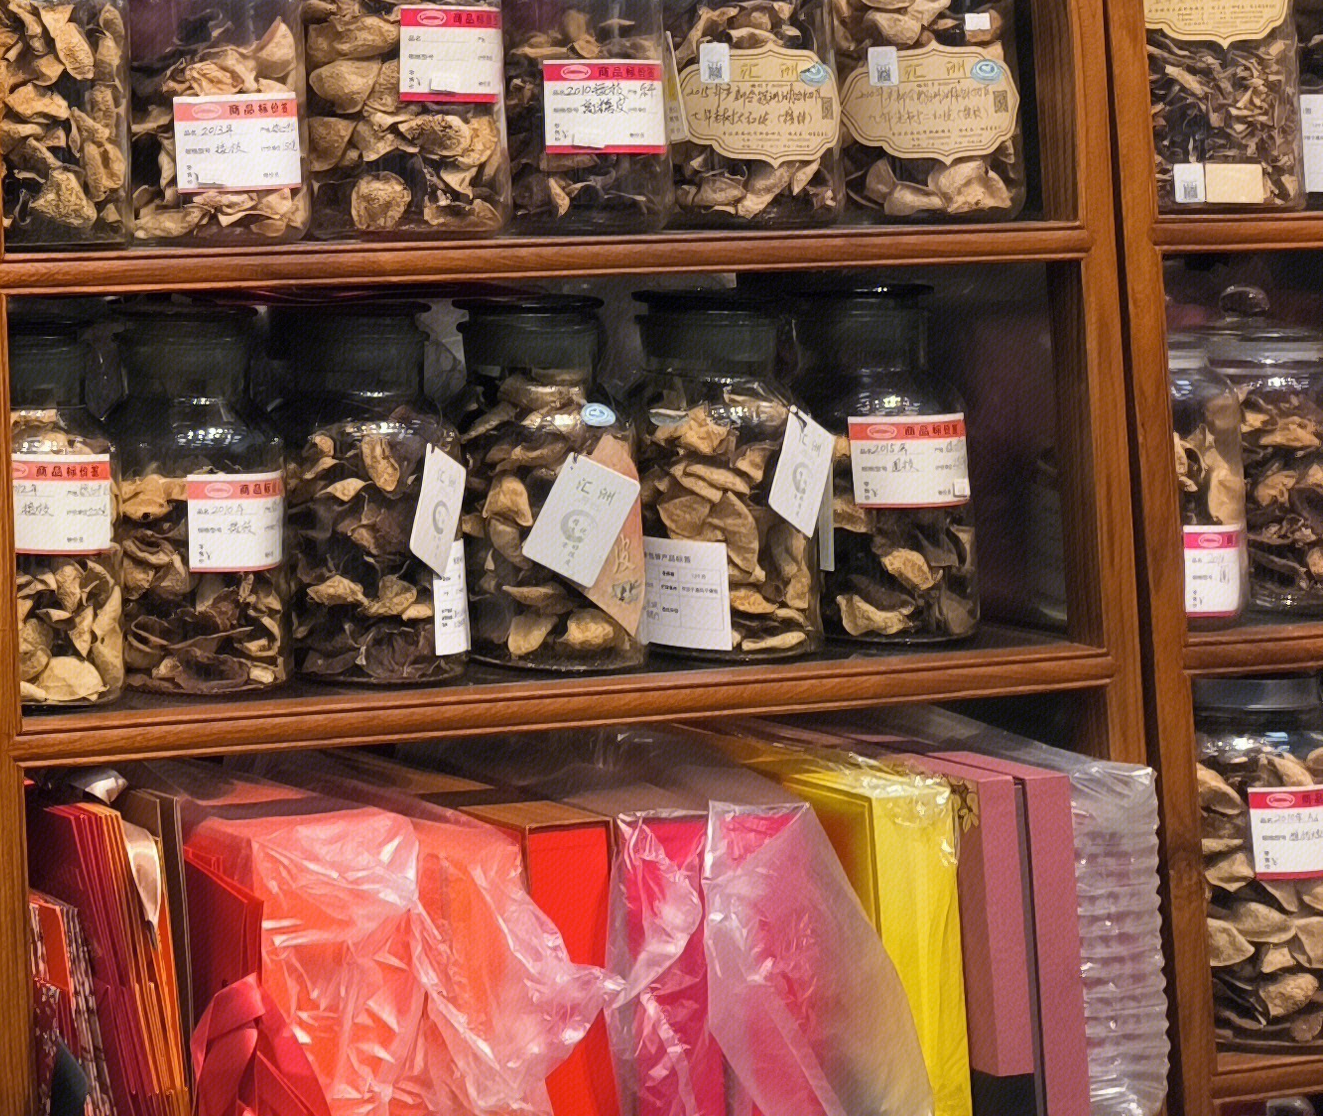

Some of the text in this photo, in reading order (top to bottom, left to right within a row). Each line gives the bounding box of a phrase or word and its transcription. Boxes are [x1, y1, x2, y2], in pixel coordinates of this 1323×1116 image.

[228, 103, 288, 115] 商品标价签
[35, 465, 99, 477] 商品标价签
